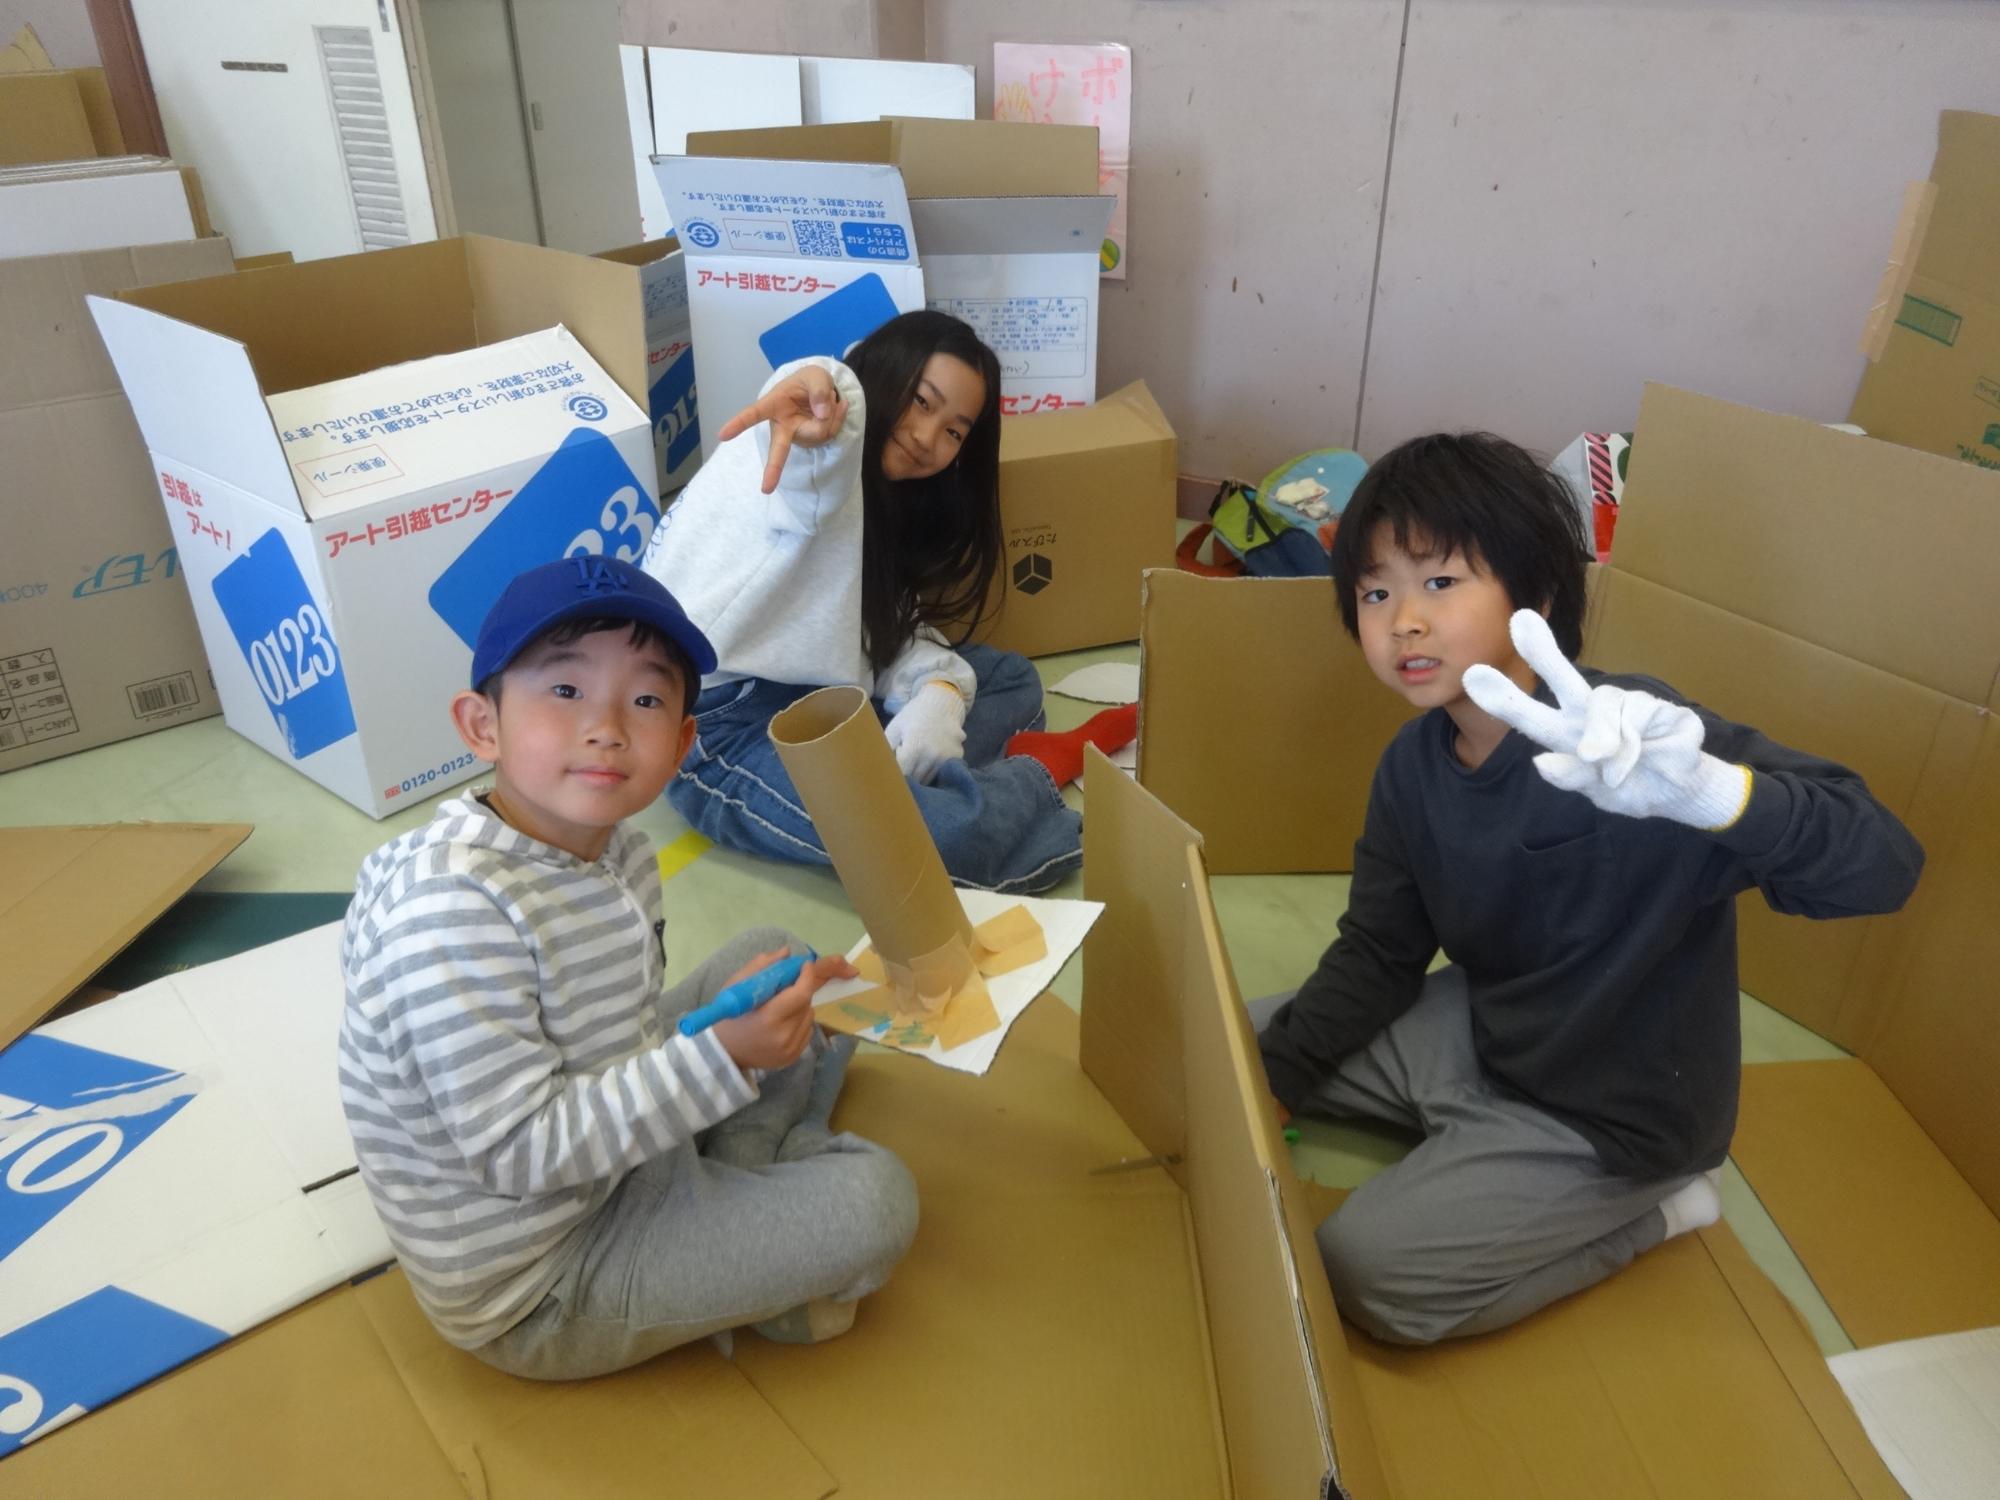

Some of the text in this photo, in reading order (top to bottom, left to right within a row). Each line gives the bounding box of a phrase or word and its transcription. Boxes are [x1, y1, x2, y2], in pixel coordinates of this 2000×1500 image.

[697, 270, 837, 293] アート引越センター
[161, 472, 205, 508] 引越は
[325, 488, 514, 559] アート引越センター
[250, 604, 336, 706] 0123
